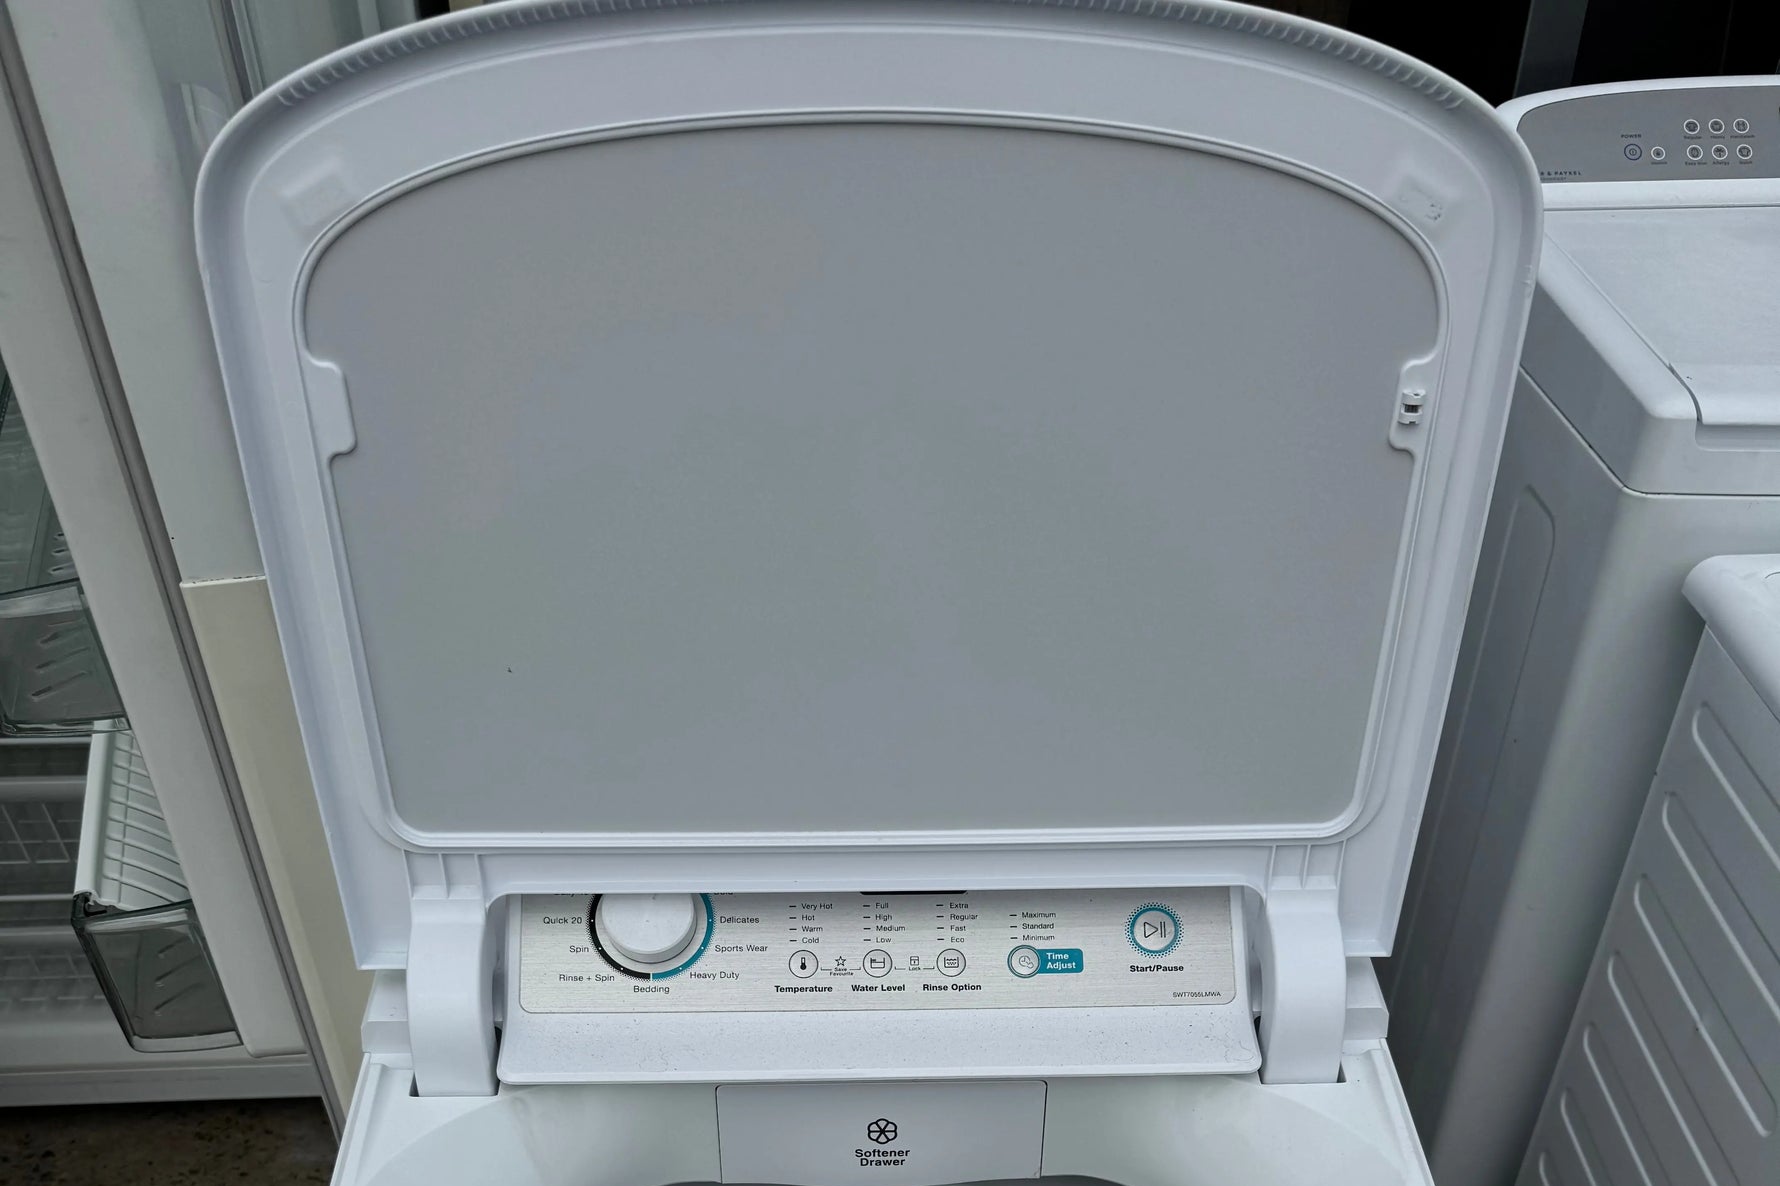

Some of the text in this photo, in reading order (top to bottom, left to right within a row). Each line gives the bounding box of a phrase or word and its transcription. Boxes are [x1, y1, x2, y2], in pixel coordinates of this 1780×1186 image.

[801, 903, 818, 911] Very
[543, 916, 582, 925] Quick 20
[719, 916, 760, 924] Delicates
[1022, 922, 1055, 930] Standard
[569, 945, 589, 954] Spin
[715, 944, 769, 953] Sports Wear
[1046, 952, 1069, 960] Time
[1046, 961, 1076, 970] Adjust
[1129, 964, 1184, 972] Start/Pause
[559, 973, 583, 981] Rinse
[595, 973, 615, 983] Spin
[690, 971, 740, 981] Heavy Duty
[633, 985, 670, 994] Bedding
[774, 985, 833, 994] Temperature
[851, 984, 906, 992] Water Level
[922, 983, 982, 992] Rinse Option
[855, 1148, 910, 1158] Softener
[860, 1157, 905, 1167] Drawer
